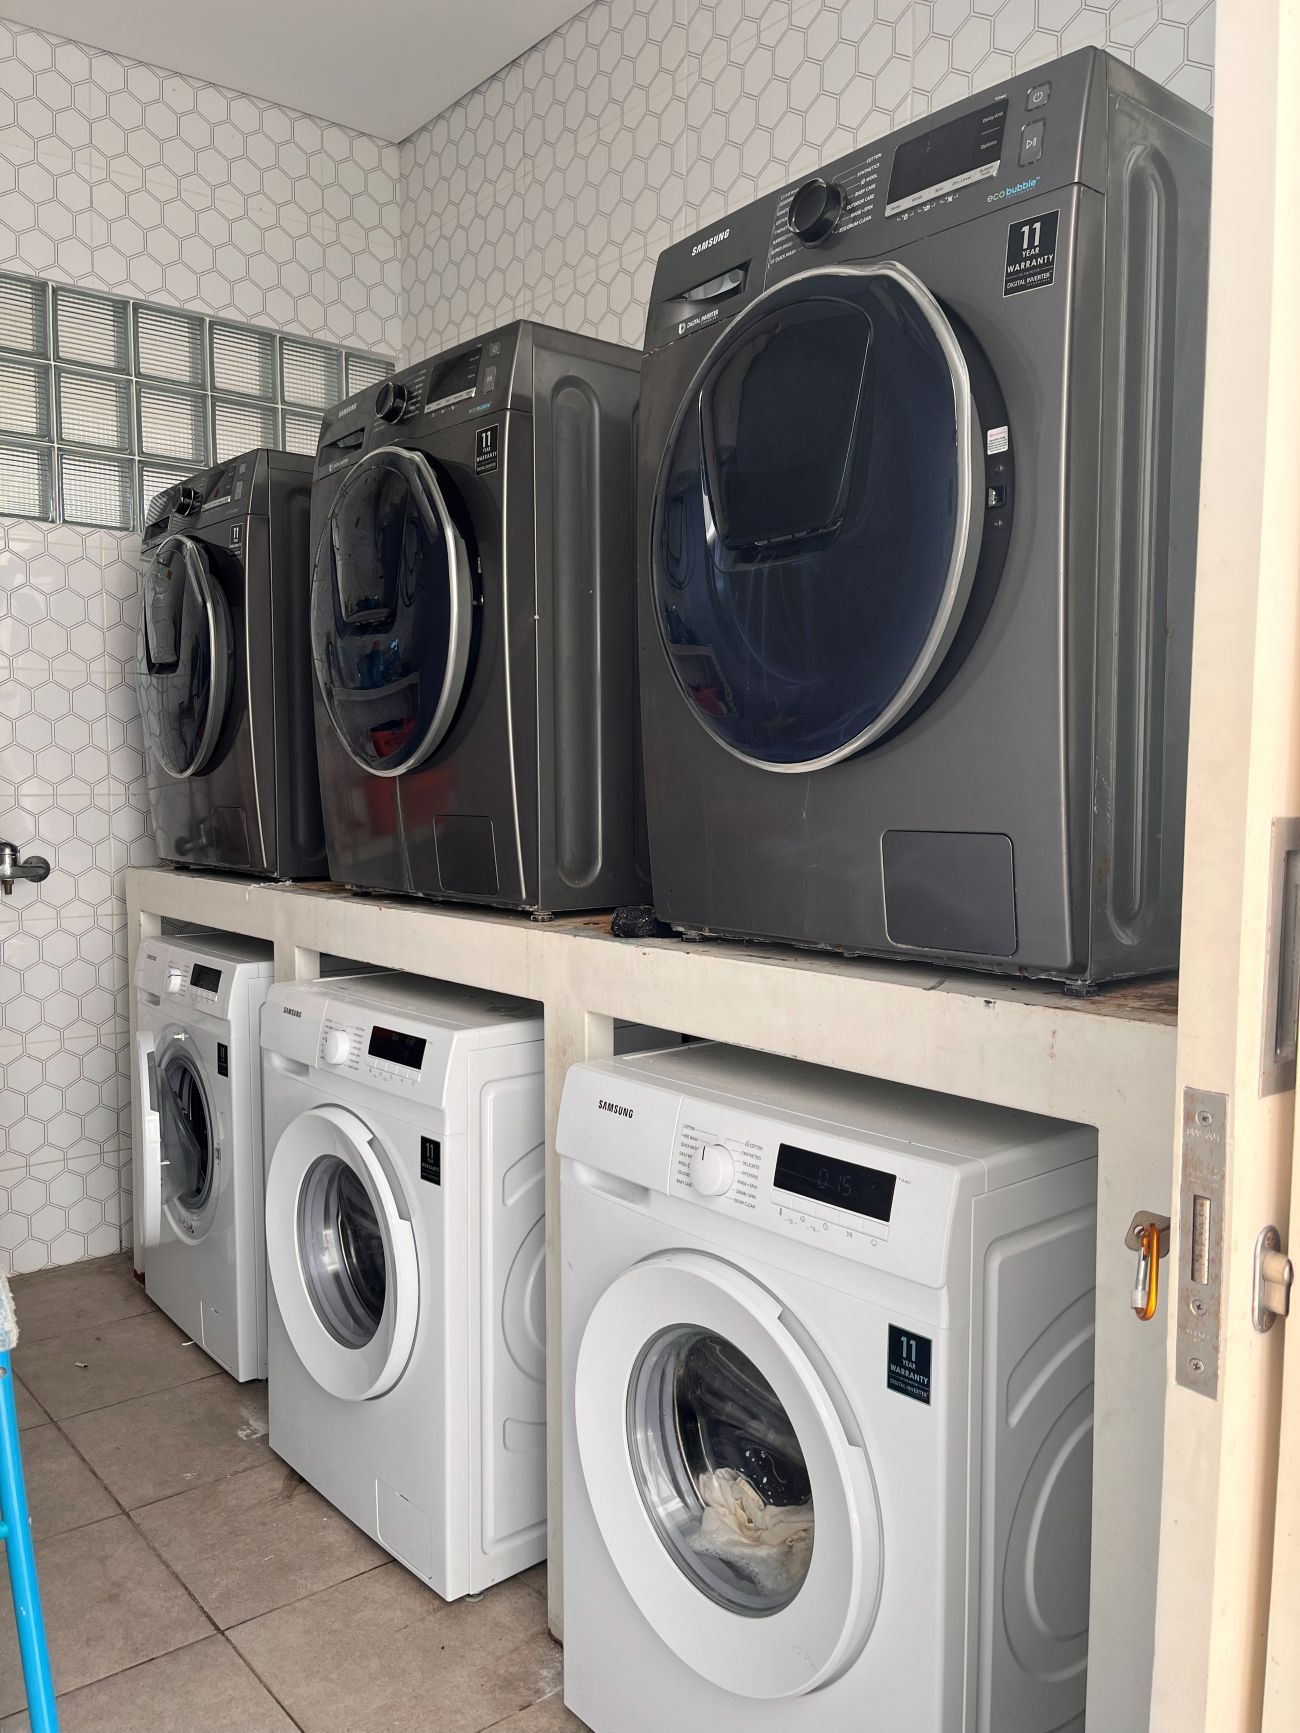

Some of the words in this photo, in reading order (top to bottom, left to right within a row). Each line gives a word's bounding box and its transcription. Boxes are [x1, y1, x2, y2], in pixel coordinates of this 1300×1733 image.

[692, 228, 730, 256] SAMSUNG
[1020, 222, 1041, 250] 11
[1022, 247, 1040, 258] YEAR
[1007, 254, 1054, 273] WARRANTY
[1006, 279, 1026, 288] DIGITAL
[482, 430, 491, 448] 11
[284, 1006, 301, 1018] SAMSUNG
[598, 1100, 634, 1119] SAMSUNG
[426, 1142, 434, 1159] 11
[900, 1336, 916, 1362] 11
[902, 1358, 916, 1370] YEAR
[890, 1363, 928, 1384] WARRANTY
